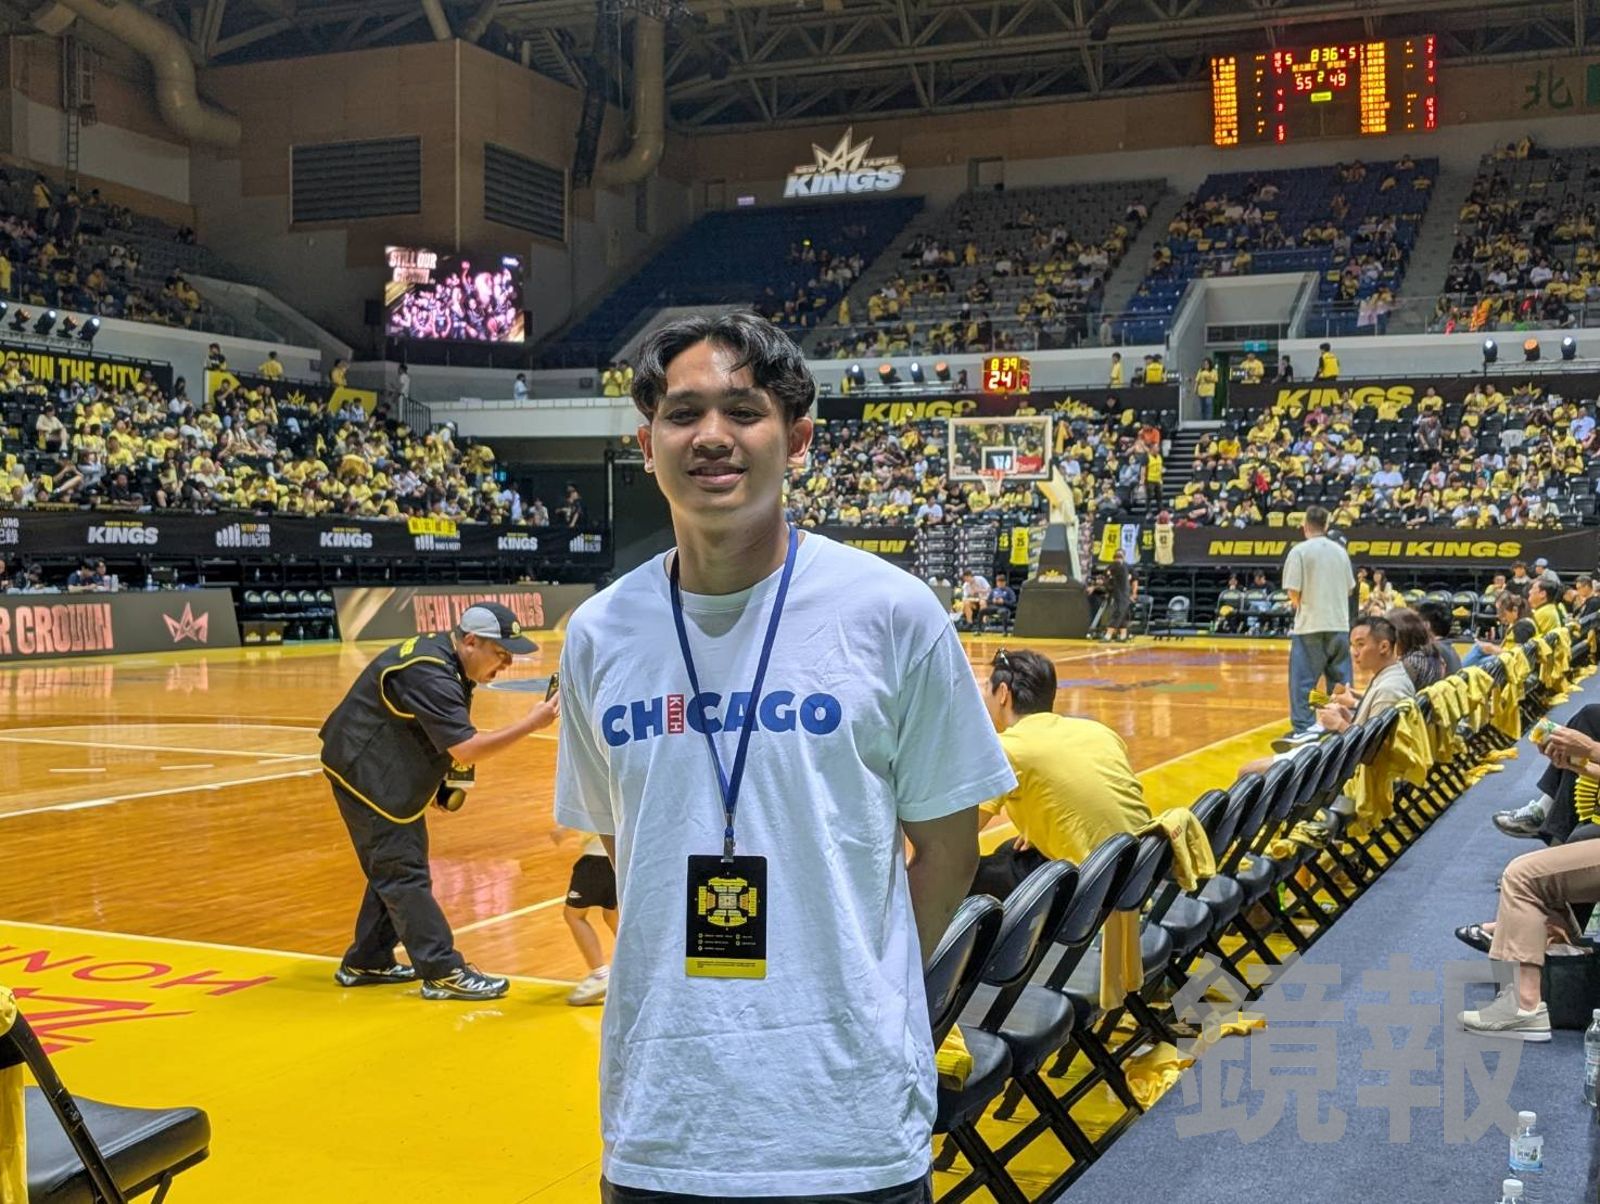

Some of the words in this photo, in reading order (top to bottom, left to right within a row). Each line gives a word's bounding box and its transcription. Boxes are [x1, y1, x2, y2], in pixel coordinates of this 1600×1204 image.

[1296, 76, 1312, 90] 55
[1330, 73, 1346, 86] 49
[784, 165, 904, 197] KINGS
[59, 358, 95, 385] THE
[99, 363, 141, 388] CITY
[988, 370, 1012, 389] 24
[1276, 386, 1415, 411] KINGS
[88, 526, 159, 545] KINGS
[320, 531, 373, 548] KINGS
[498, 536, 538, 551] KINGS
[1208, 541, 1287, 556] NEW
[1405, 541, 1523, 558] KINGS
[414, 595, 452, 633] NEW
[669, 695, 683, 732] KITH
